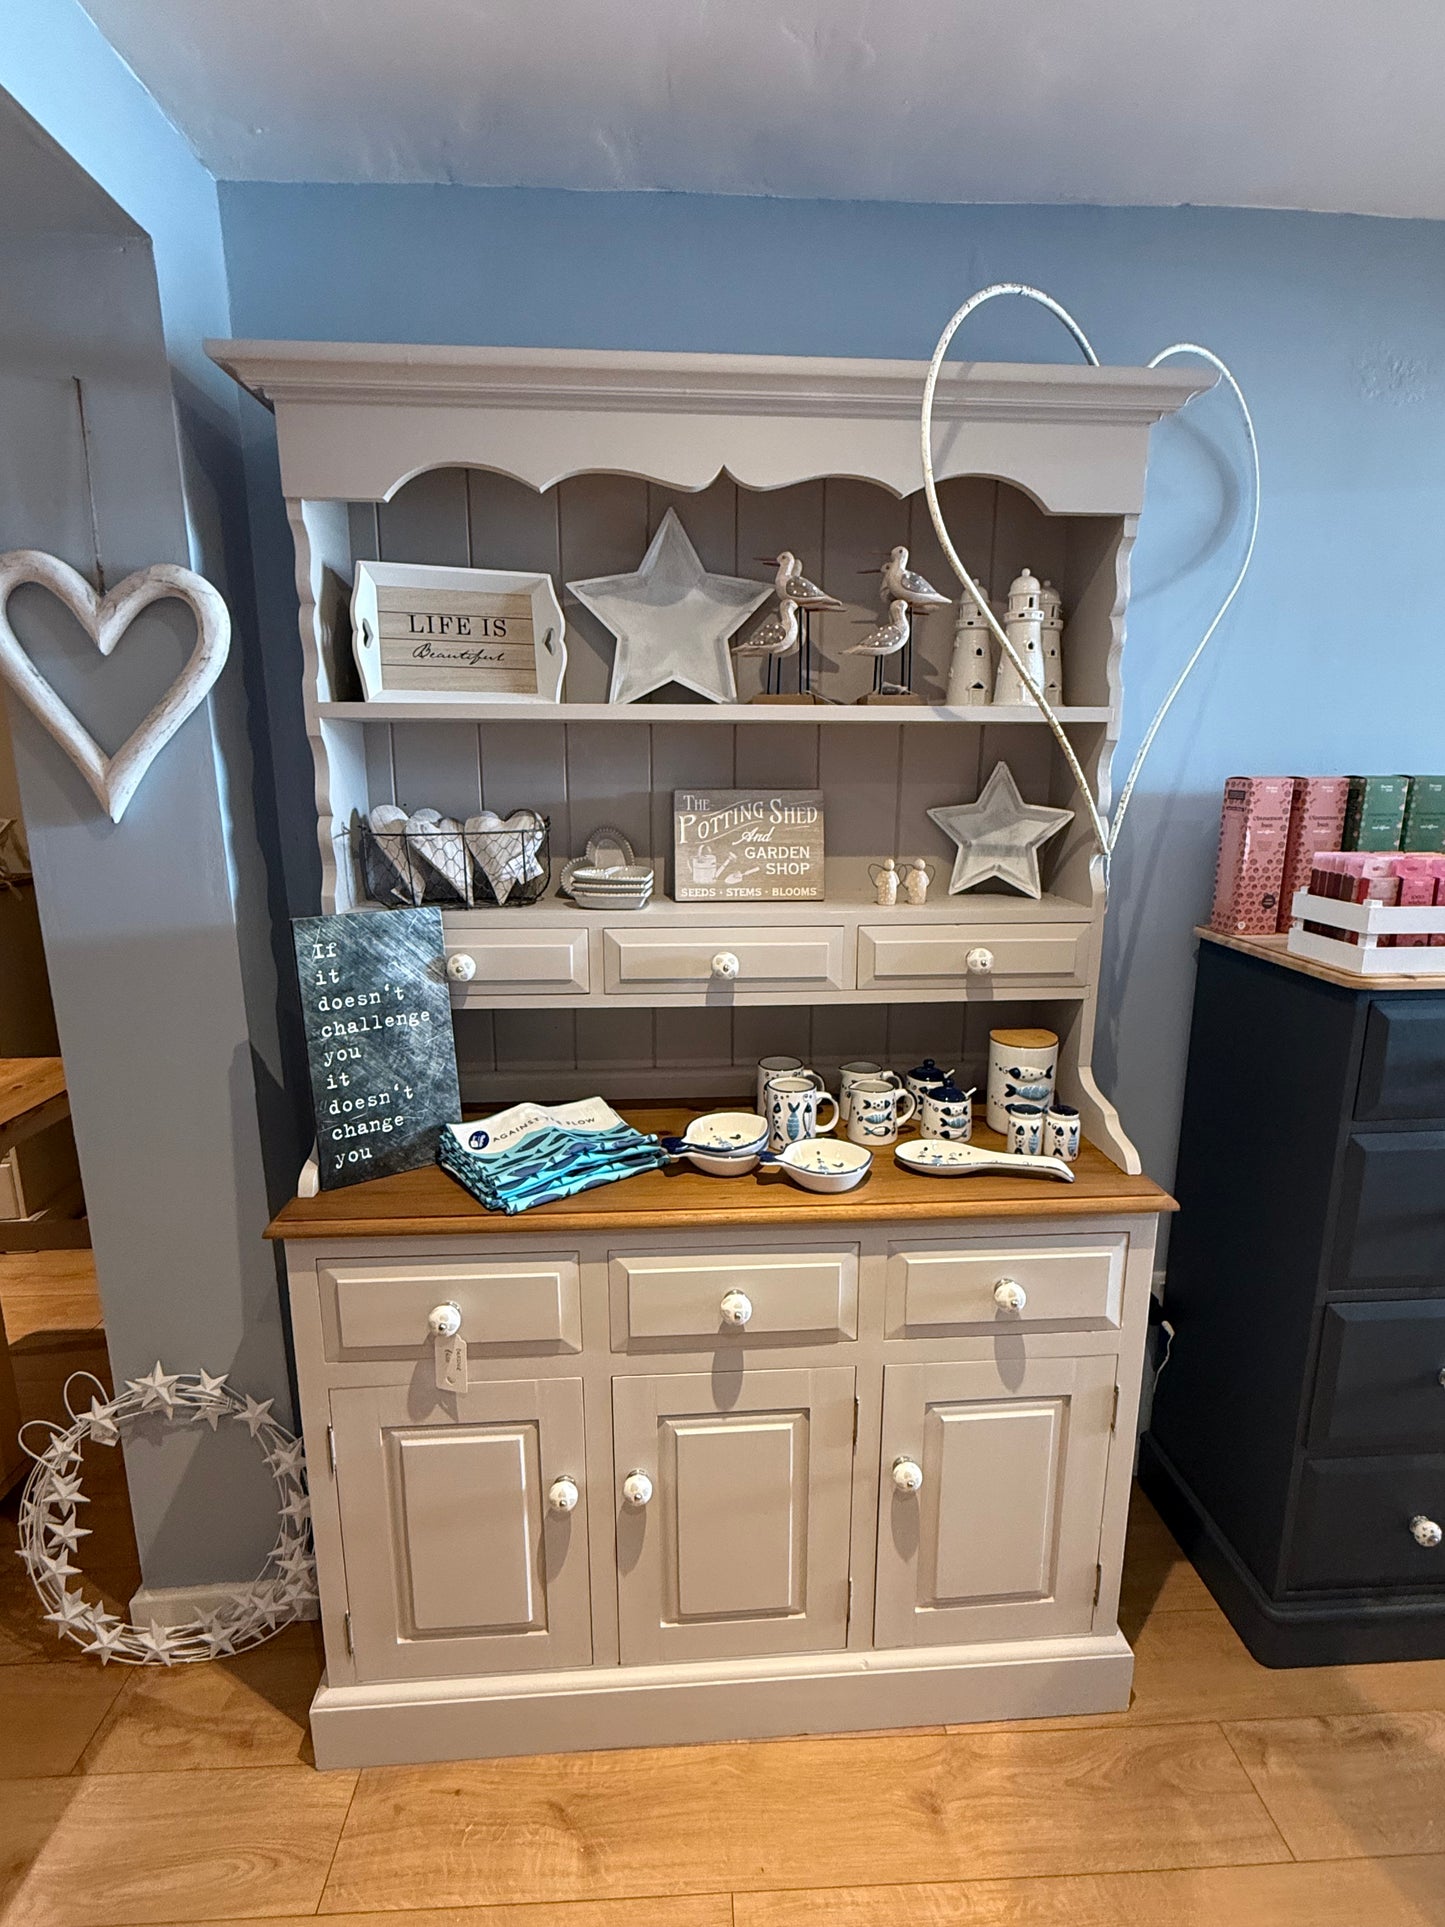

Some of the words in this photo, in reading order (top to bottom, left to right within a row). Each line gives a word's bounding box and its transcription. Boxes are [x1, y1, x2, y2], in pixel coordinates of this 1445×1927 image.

[409, 614, 471, 635] LIFE
[482, 618, 507, 637] IS
[412, 642, 505, 665] Beautiful
[683, 794, 710, 811] THE
[679, 801, 764, 844] POTTING
[769, 798, 817, 824] SHED
[732, 827, 775, 845] And
[744, 846, 810, 859] GARDEN
[765, 862, 810, 875] SHOP
[681, 887, 716, 897] SEEDS
[726, 887, 762, 897] STEMS
[772, 887, 817, 897] BLOOMS
[313, 942, 337, 959] If
[316, 968, 340, 985] it
[321, 1010, 430, 1038] challenge
[323, 1046, 361, 1067] you
[326, 1072, 349, 1090] it
[331, 1114, 405, 1141] change
[493, 1117, 540, 1142] AGAINST
[335, 1146, 372, 1170] you
